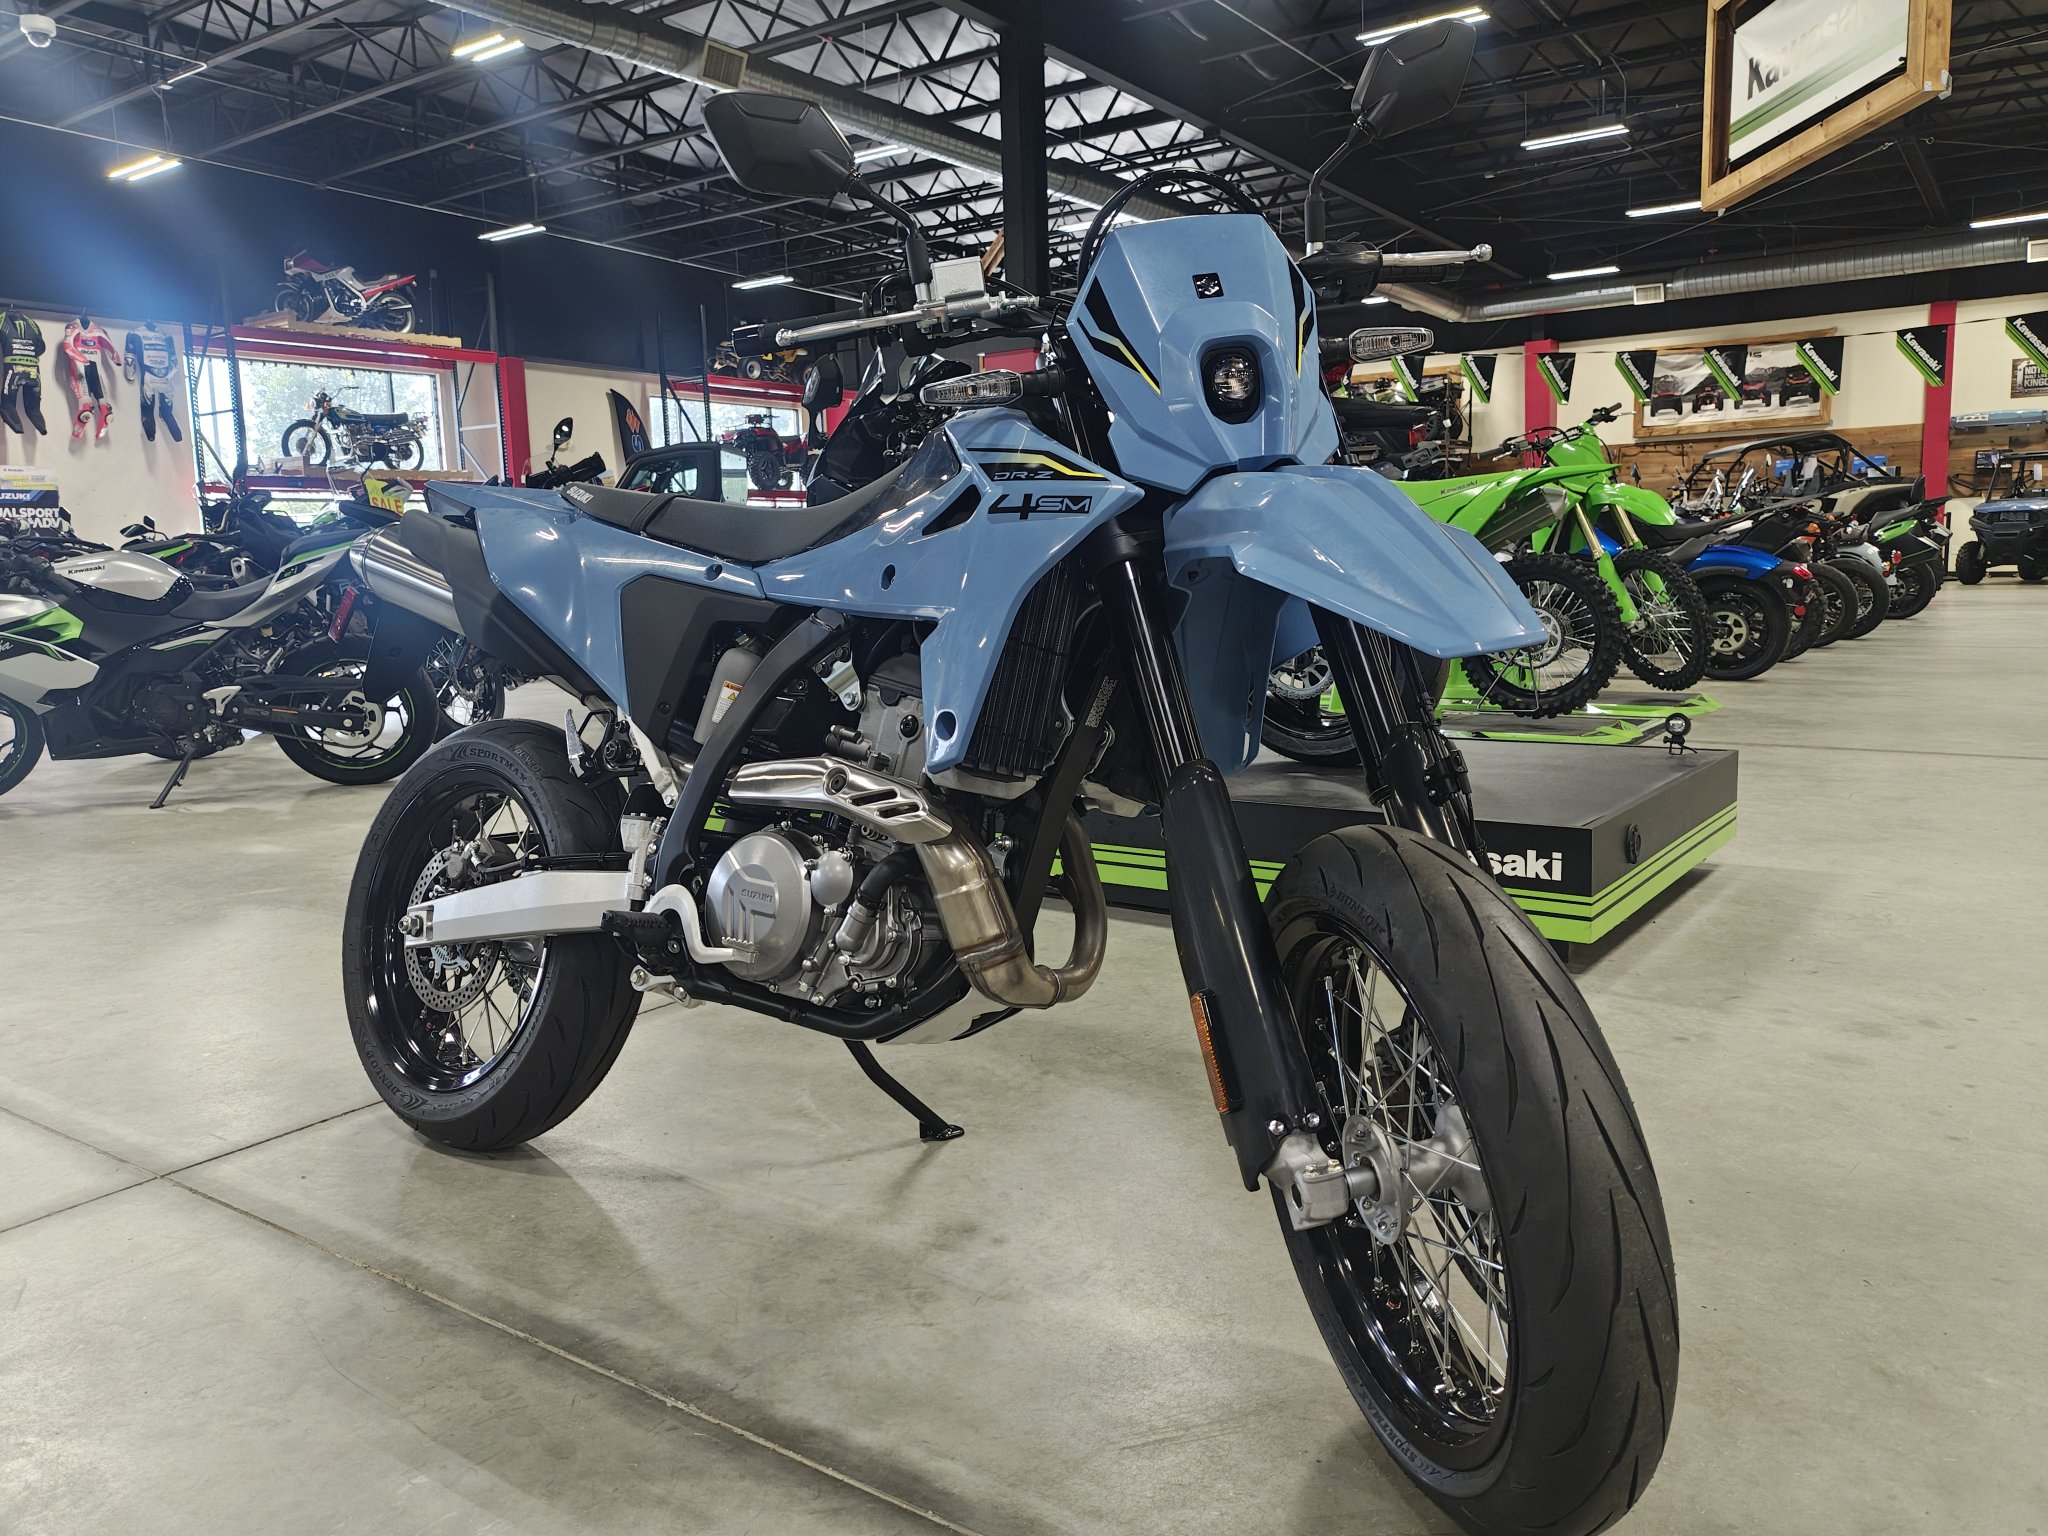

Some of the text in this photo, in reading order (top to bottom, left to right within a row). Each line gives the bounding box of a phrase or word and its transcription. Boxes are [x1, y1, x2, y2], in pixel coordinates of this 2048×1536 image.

[1709, 348, 1742, 388] Kawasaki
[1802, 341, 1839, 382] Kawasaki
[1903, 331, 1942, 373] Kawasaki
[1464, 354, 1490, 392] Kawasaki
[1542, 354, 1569, 393] Kawasaki
[1620, 352, 1651, 391] Kawasaki
[566, 485, 595, 504] SUZUKI
[993, 470, 1054, 481] DR-Z
[1440, 480, 1478, 496] Kawasaki
[371, 496, 404, 516] SALE
[67, 565, 105, 575] Kawasaki
[469, 747, 528, 785] SPORTMAX
[741, 889, 774, 904] SUZUKI
[1336, 889, 1386, 935] DUNLOP
[366, 1049, 401, 1095] DUNLOP
[1357, 1384, 1419, 1463] SPORTMAX
